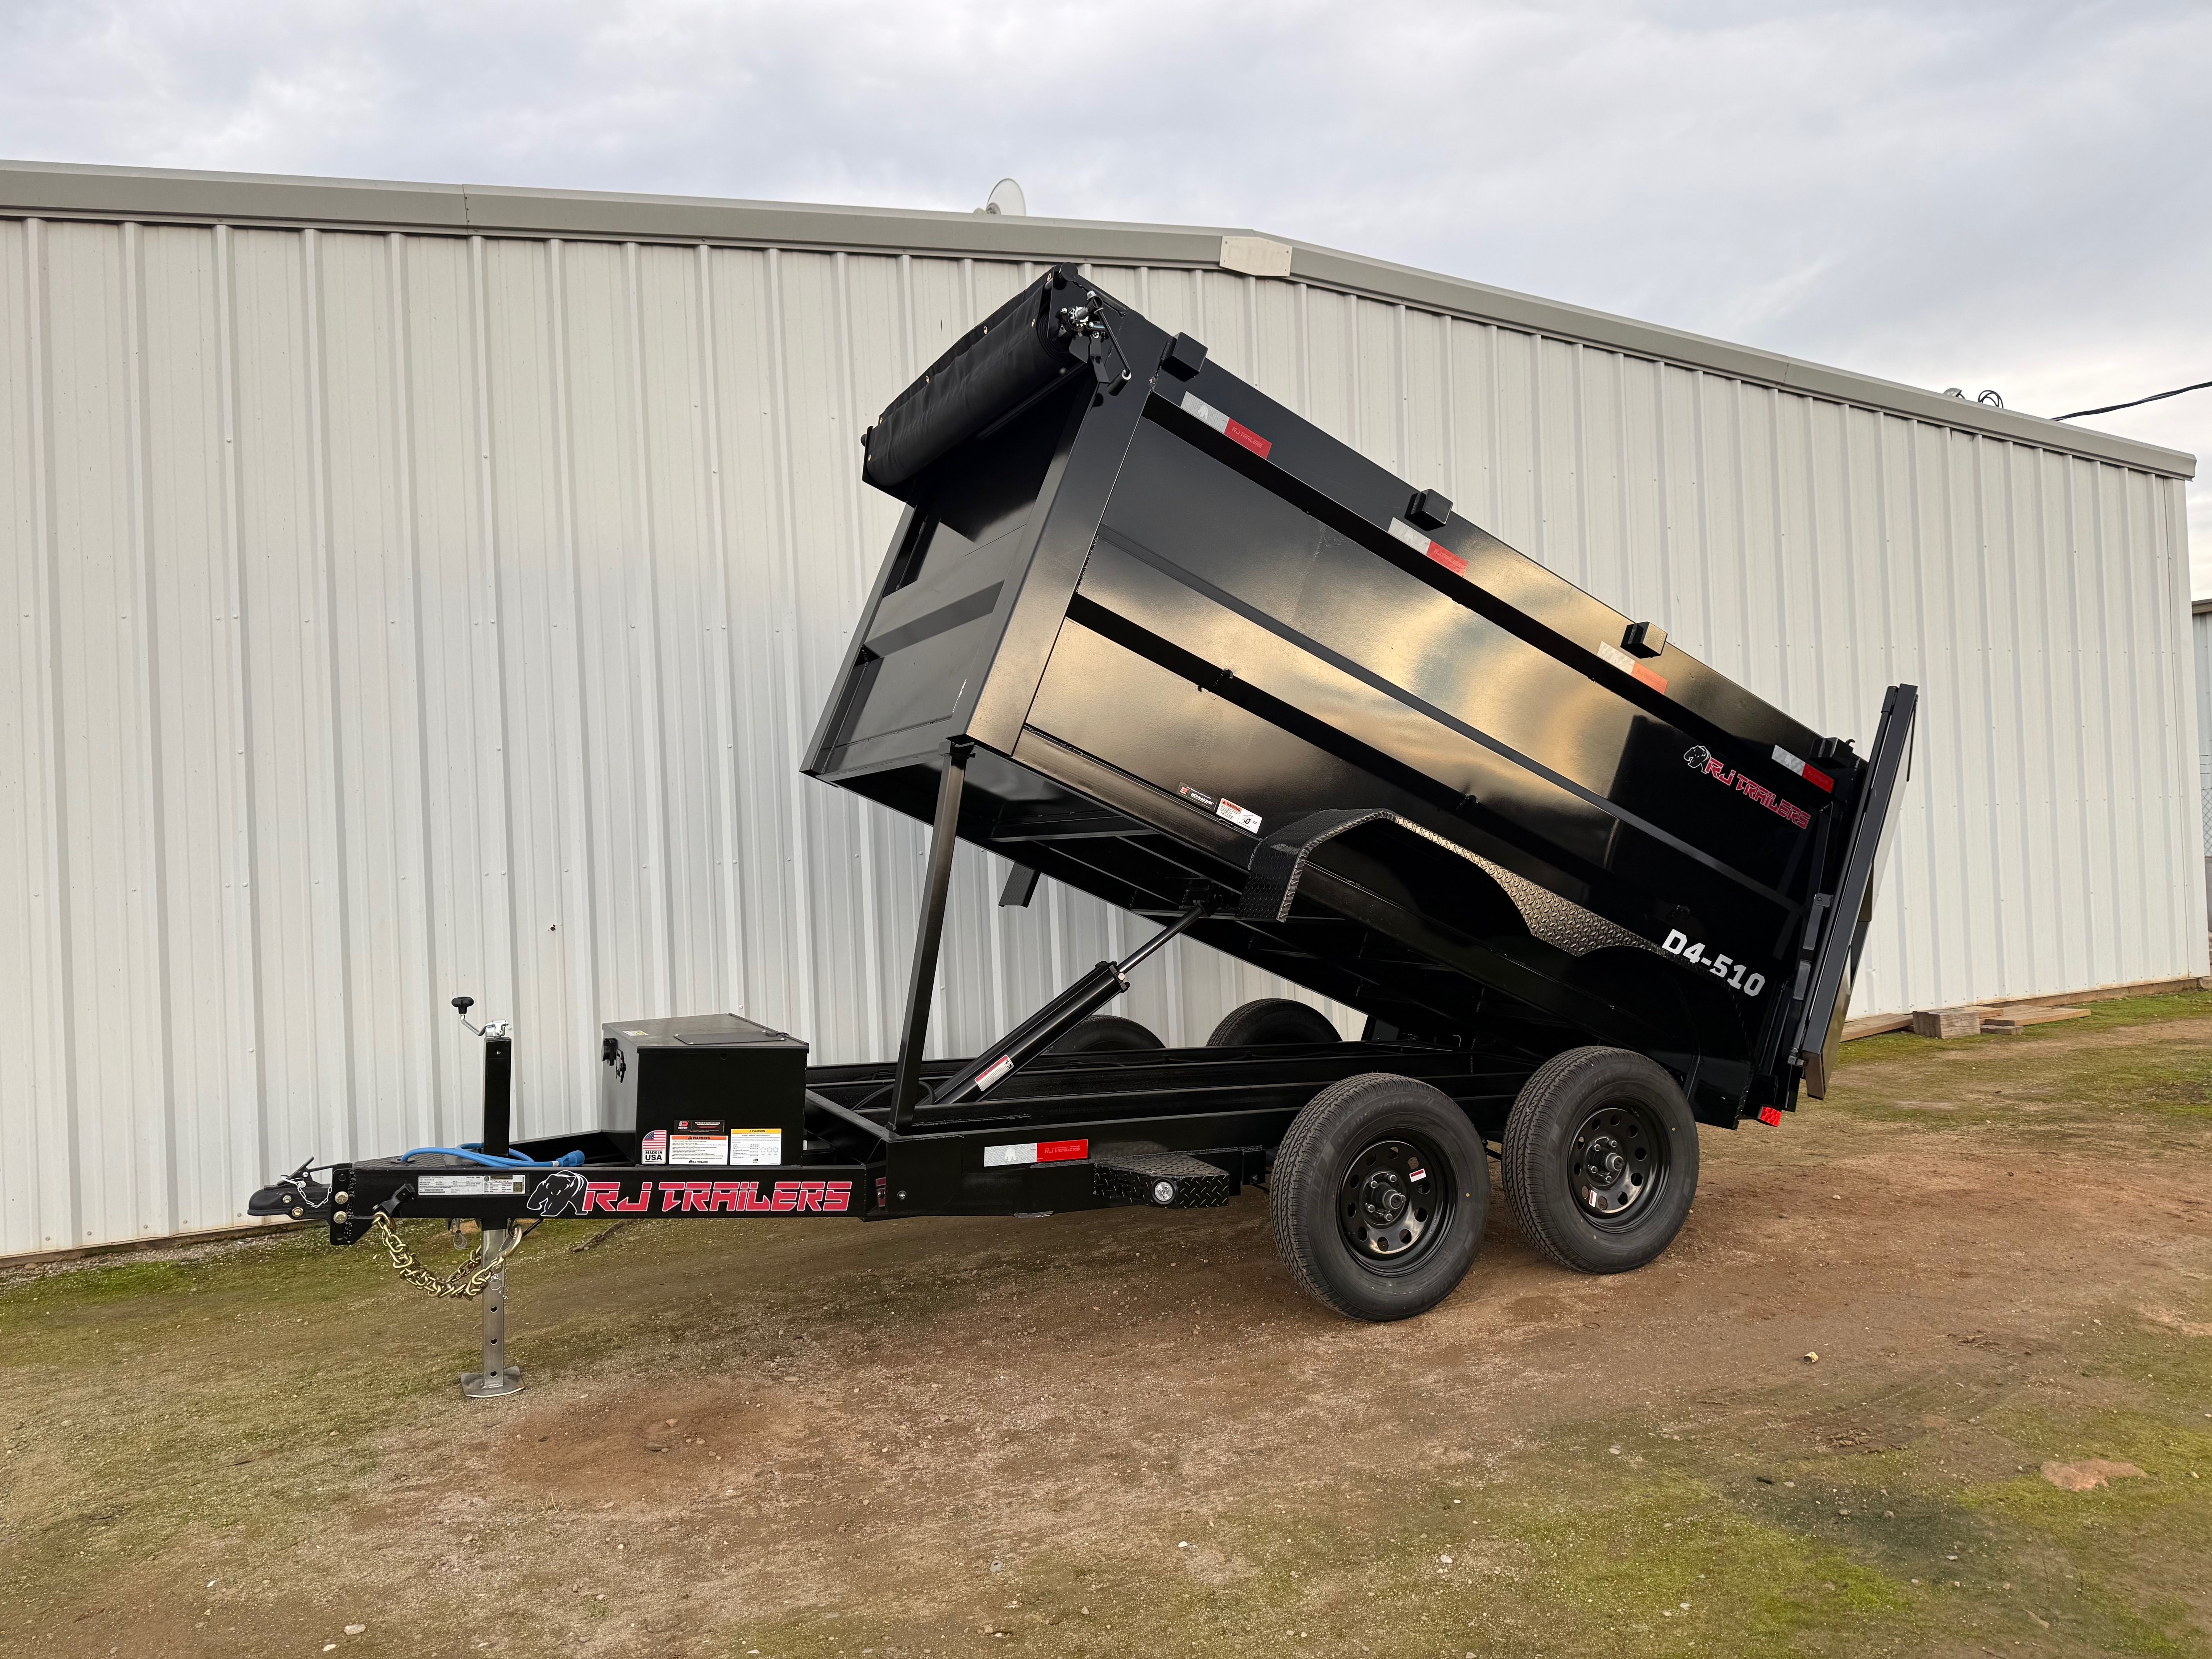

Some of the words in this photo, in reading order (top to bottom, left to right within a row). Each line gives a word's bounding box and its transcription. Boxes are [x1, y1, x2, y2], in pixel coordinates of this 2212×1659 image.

[1704, 757, 1736, 786] RJ
[1735, 773, 1811, 830] TRAILERS
[1661, 928, 1765, 997] D4-510
[584, 1182, 652, 1212] RJ
[659, 1181, 852, 1212] TRAILERS
